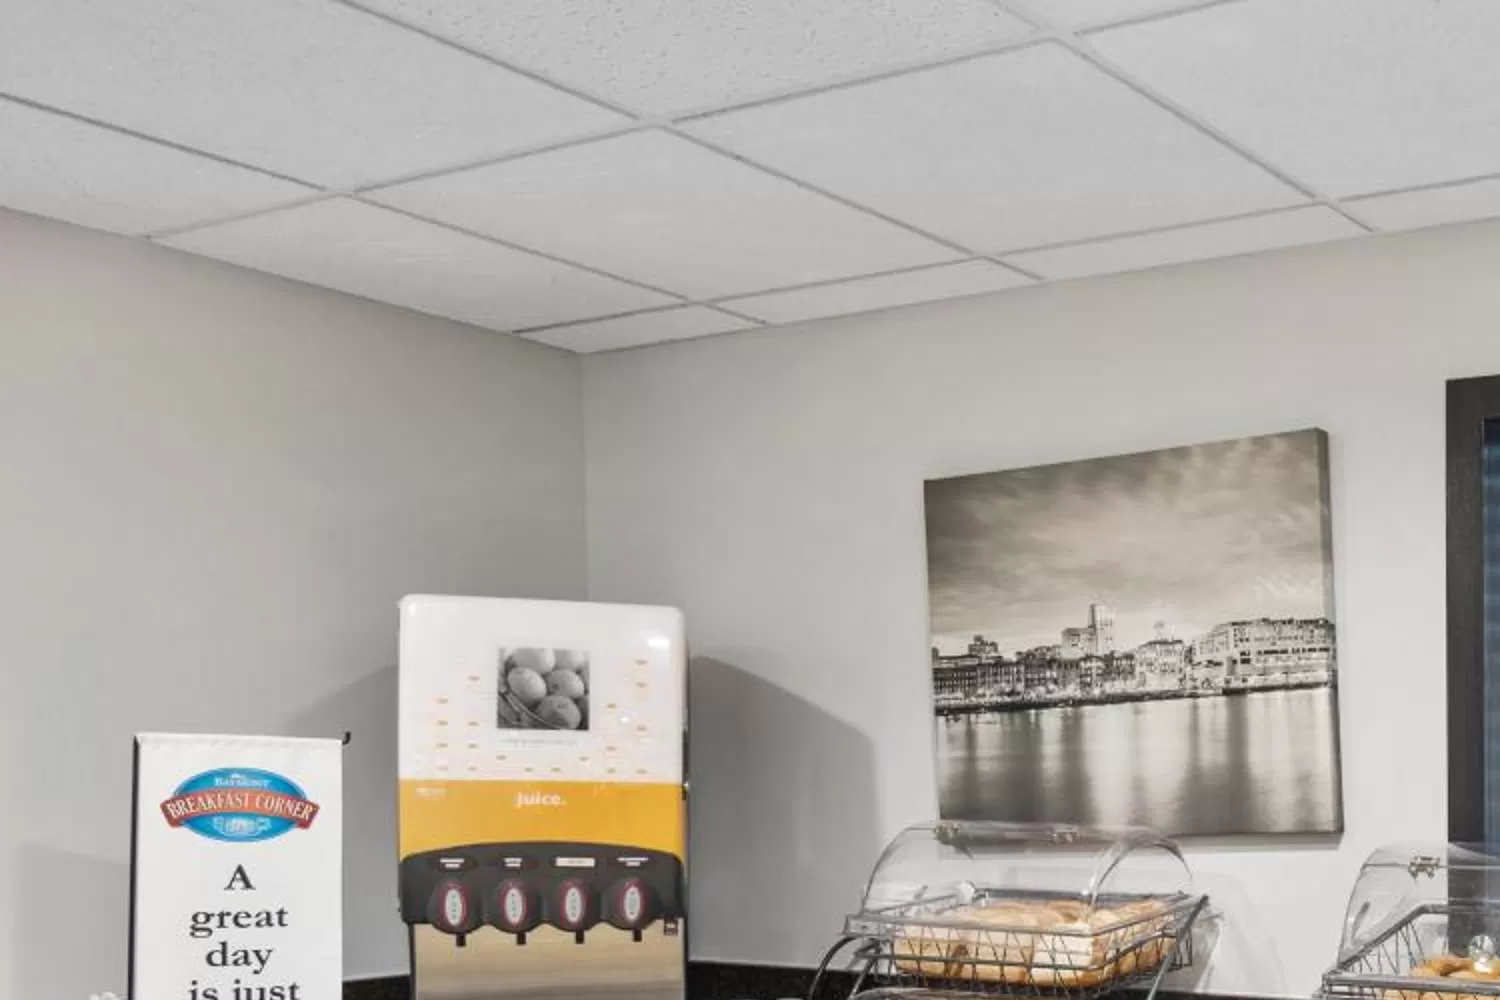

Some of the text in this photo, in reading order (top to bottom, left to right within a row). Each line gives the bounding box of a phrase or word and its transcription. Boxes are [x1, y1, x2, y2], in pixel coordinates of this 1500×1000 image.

[166, 791, 314, 820] BREAKFAST CORNER
[224, 864, 256, 891] A
[189, 907, 289, 938] great
[205, 942, 273, 975] day
